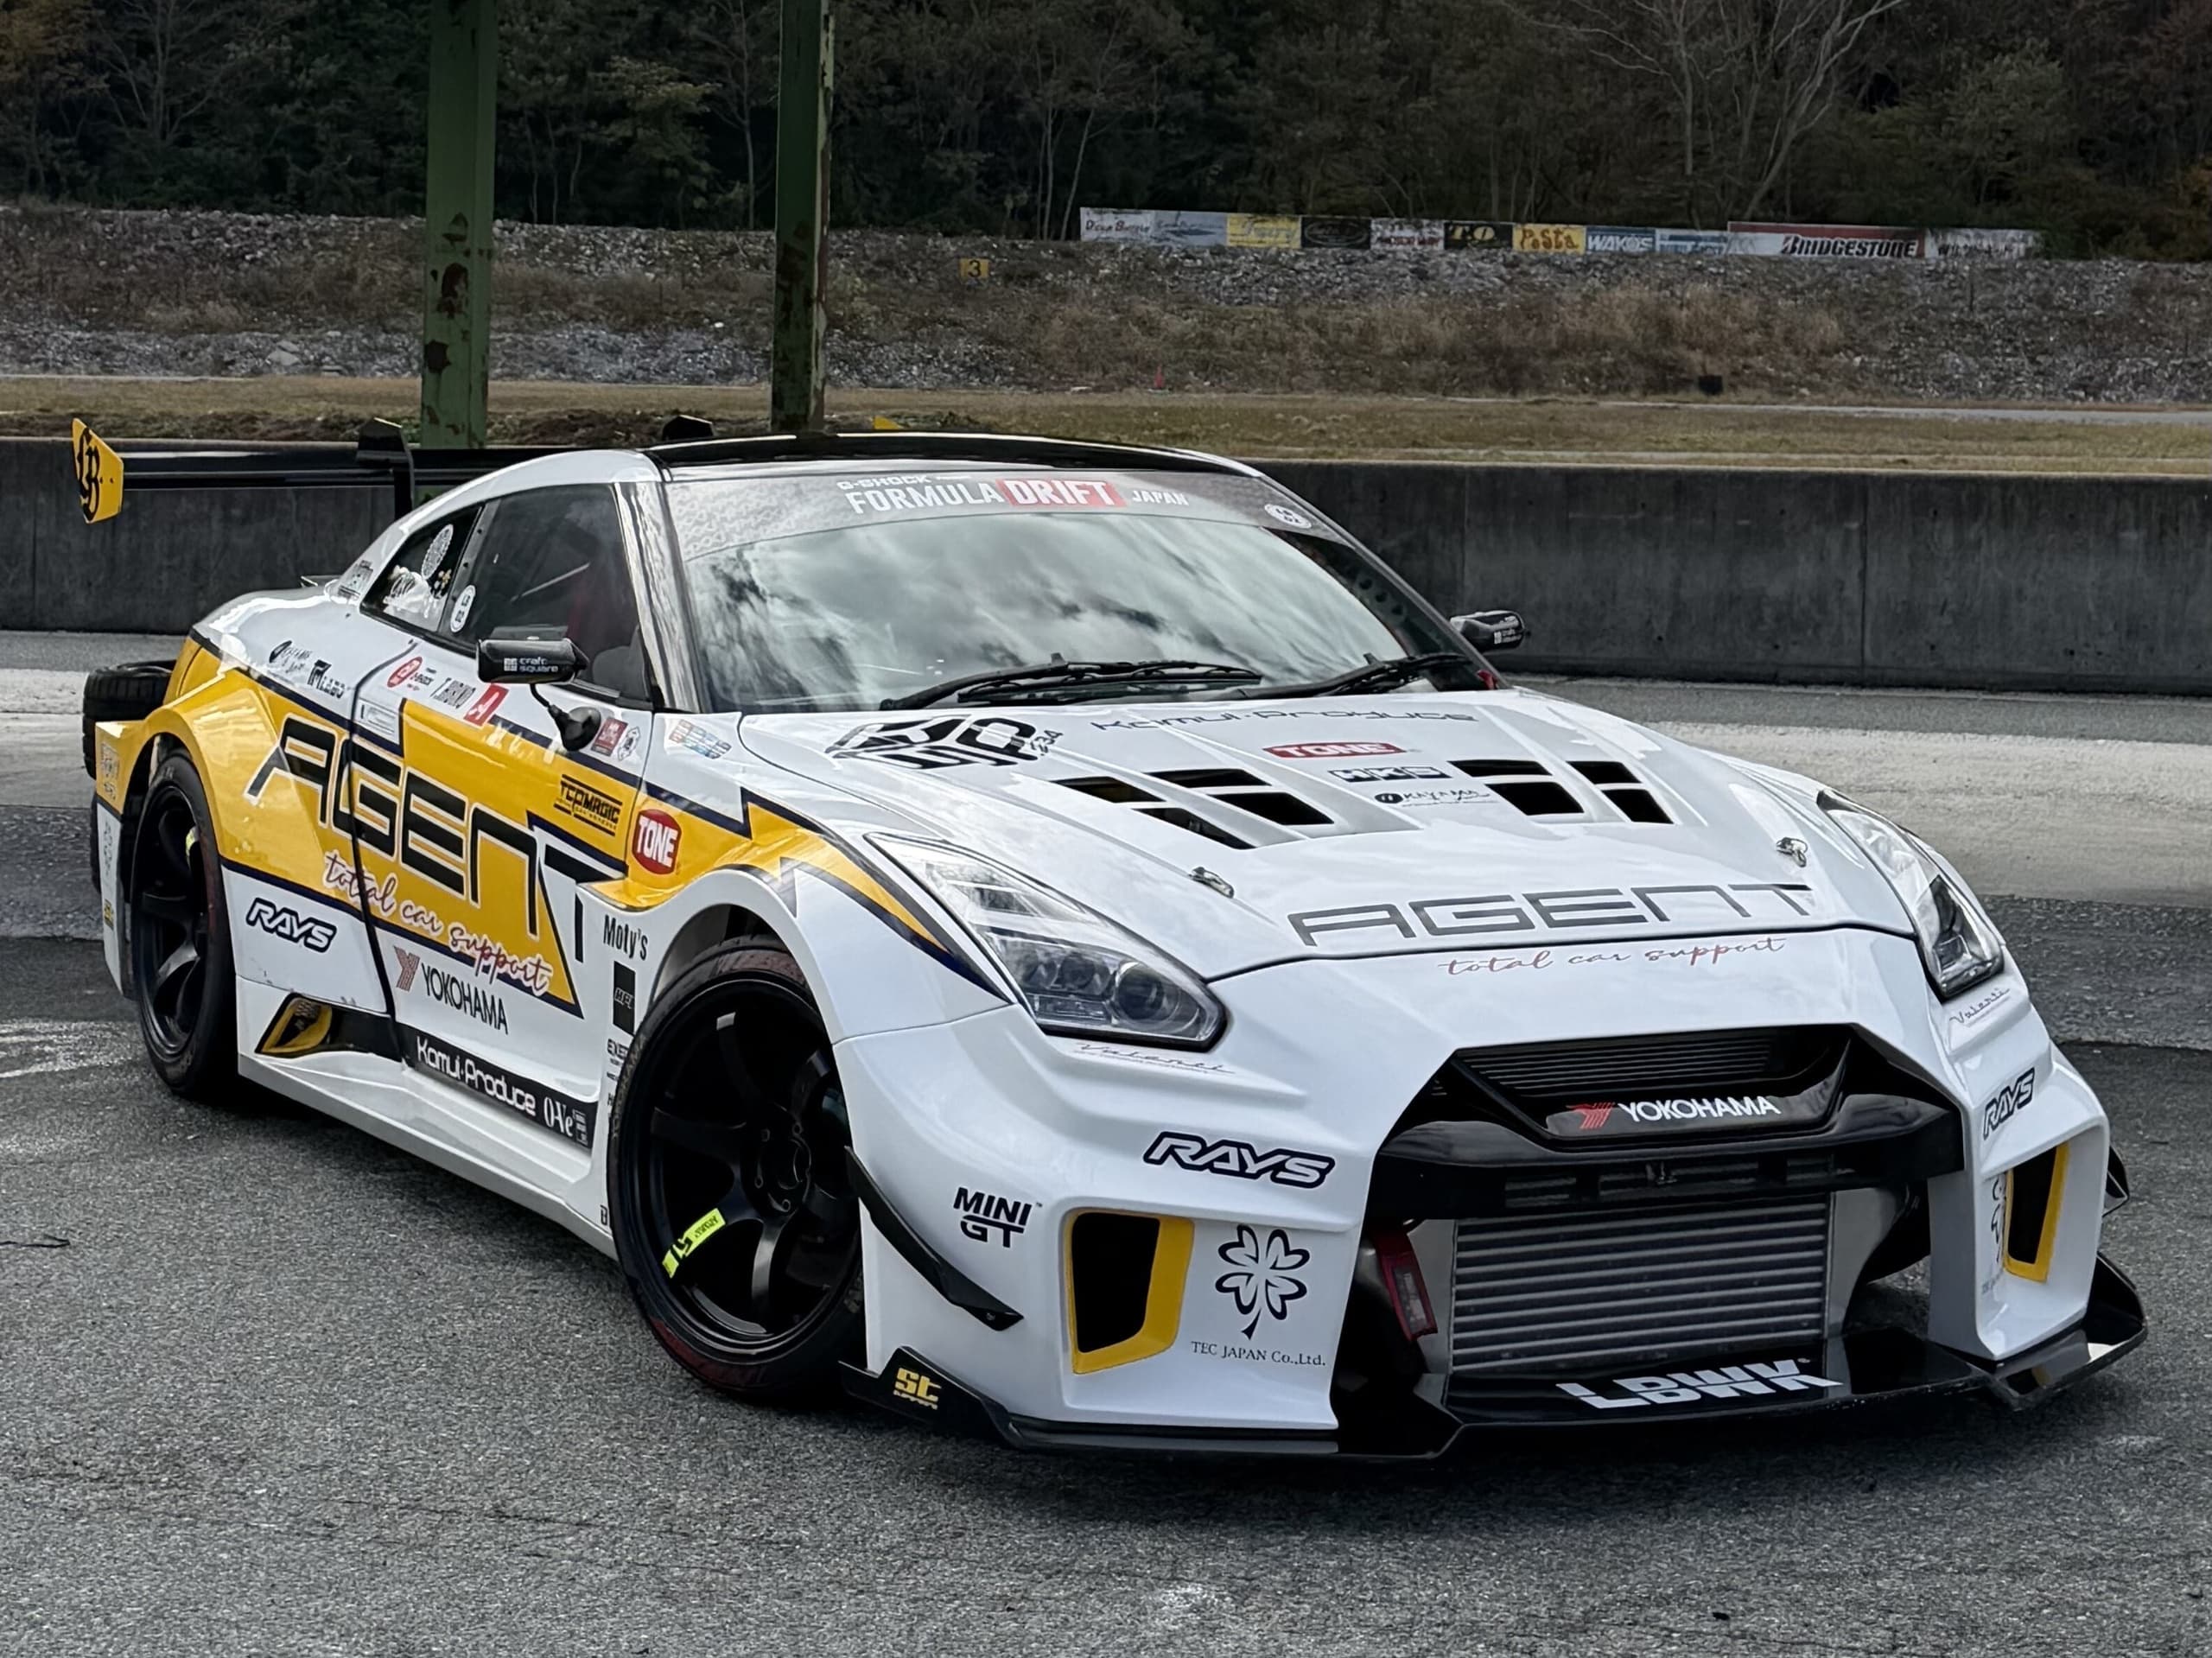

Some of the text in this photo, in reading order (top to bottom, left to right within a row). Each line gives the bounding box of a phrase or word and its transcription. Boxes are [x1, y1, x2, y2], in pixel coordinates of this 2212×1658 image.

[968, 259, 982, 277] 3
[845, 480, 1189, 513] FORMULA DRIFT JAPAN
[1272, 743, 1391, 758] TONE
[245, 716, 627, 962] AGENT
[636, 814, 679, 869] TONE
[245, 898, 337, 952] RAYS
[325, 853, 552, 992] total car support
[603, 914, 648, 961] Moty's
[1287, 884, 1812, 946] AGENT
[1438, 937, 1787, 975] total car support
[421, 963, 508, 1035] YOKOHAMA
[1618, 1096, 1781, 1121] YOKOHAMA
[1983, 1067, 2035, 1141] RAYS
[1143, 1131, 1336, 1190] RAYS
[953, 1186, 1033, 1226] MINI
[960, 1215, 1027, 1248] GT
[1191, 1341, 1217, 1355] TEC
[1221, 1345, 1268, 1361] JAPAN
